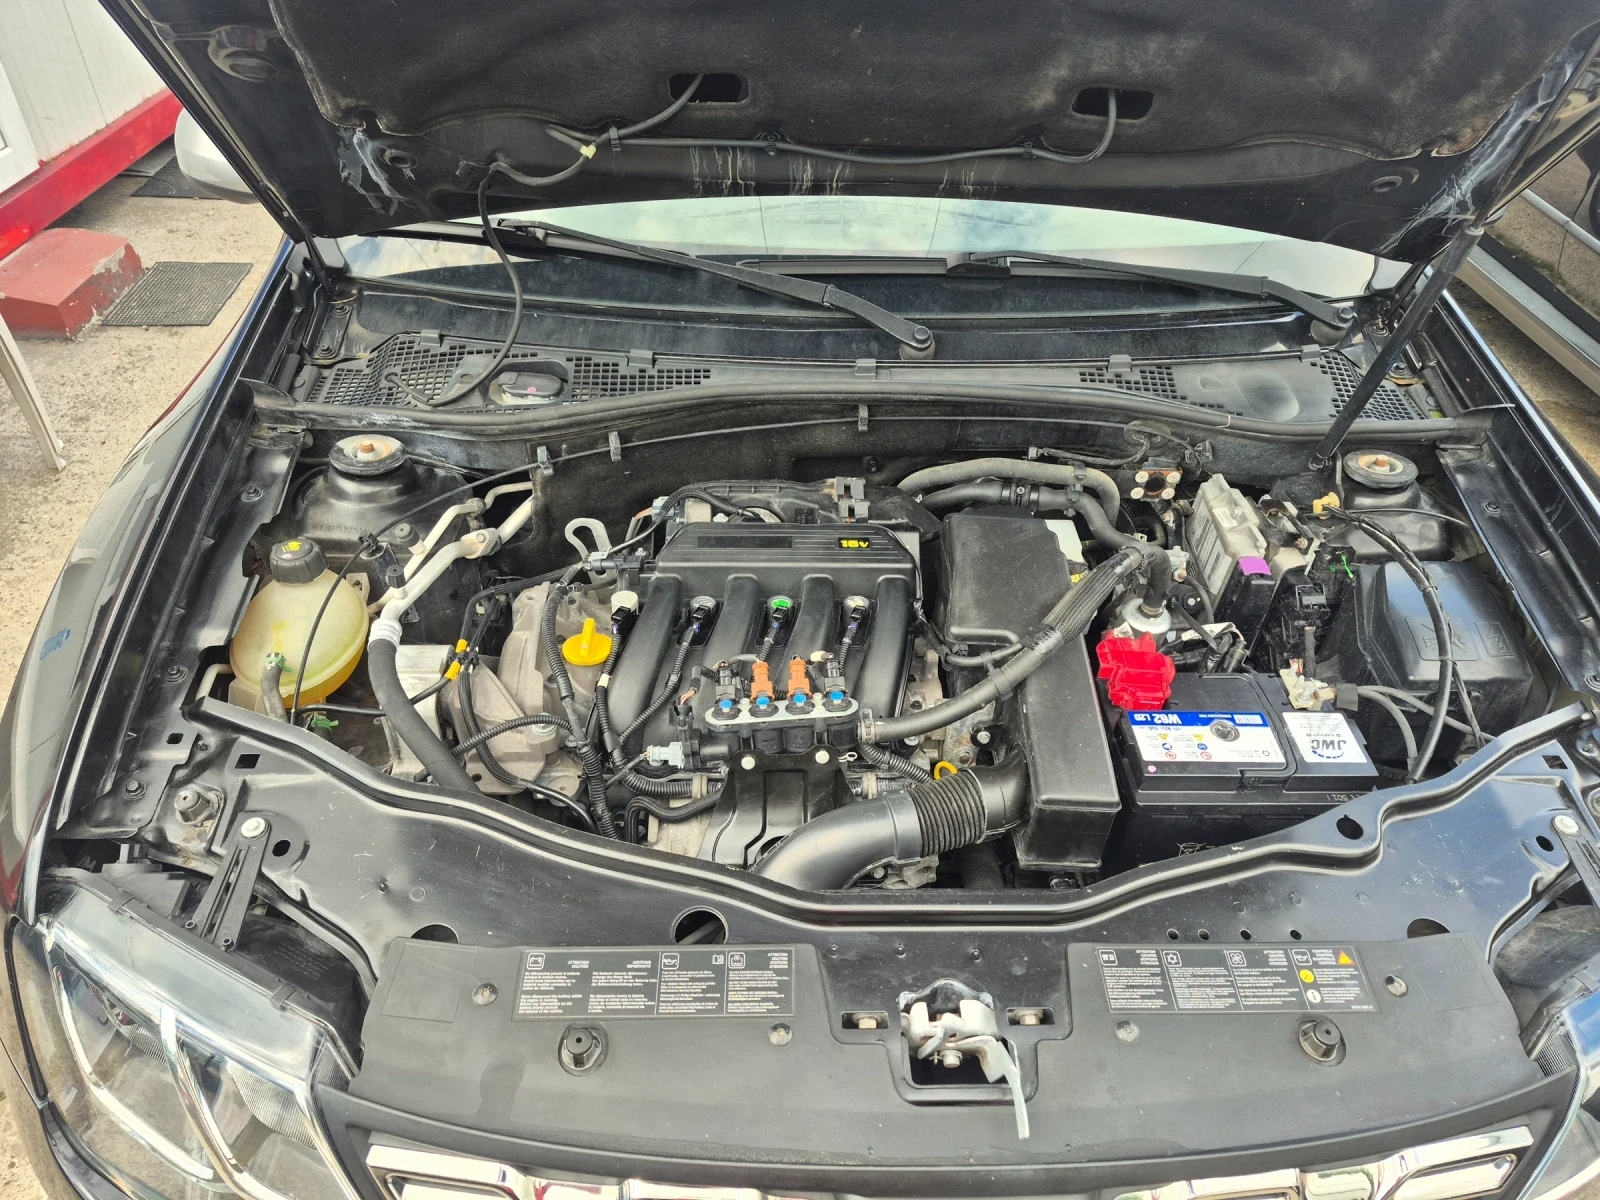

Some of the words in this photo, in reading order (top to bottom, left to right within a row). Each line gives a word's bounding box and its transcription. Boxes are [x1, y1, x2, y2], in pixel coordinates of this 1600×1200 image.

[840, 540, 869, 548] 16v
[1152, 714, 1182, 724] W62
[1310, 739, 1347, 751] JWC
